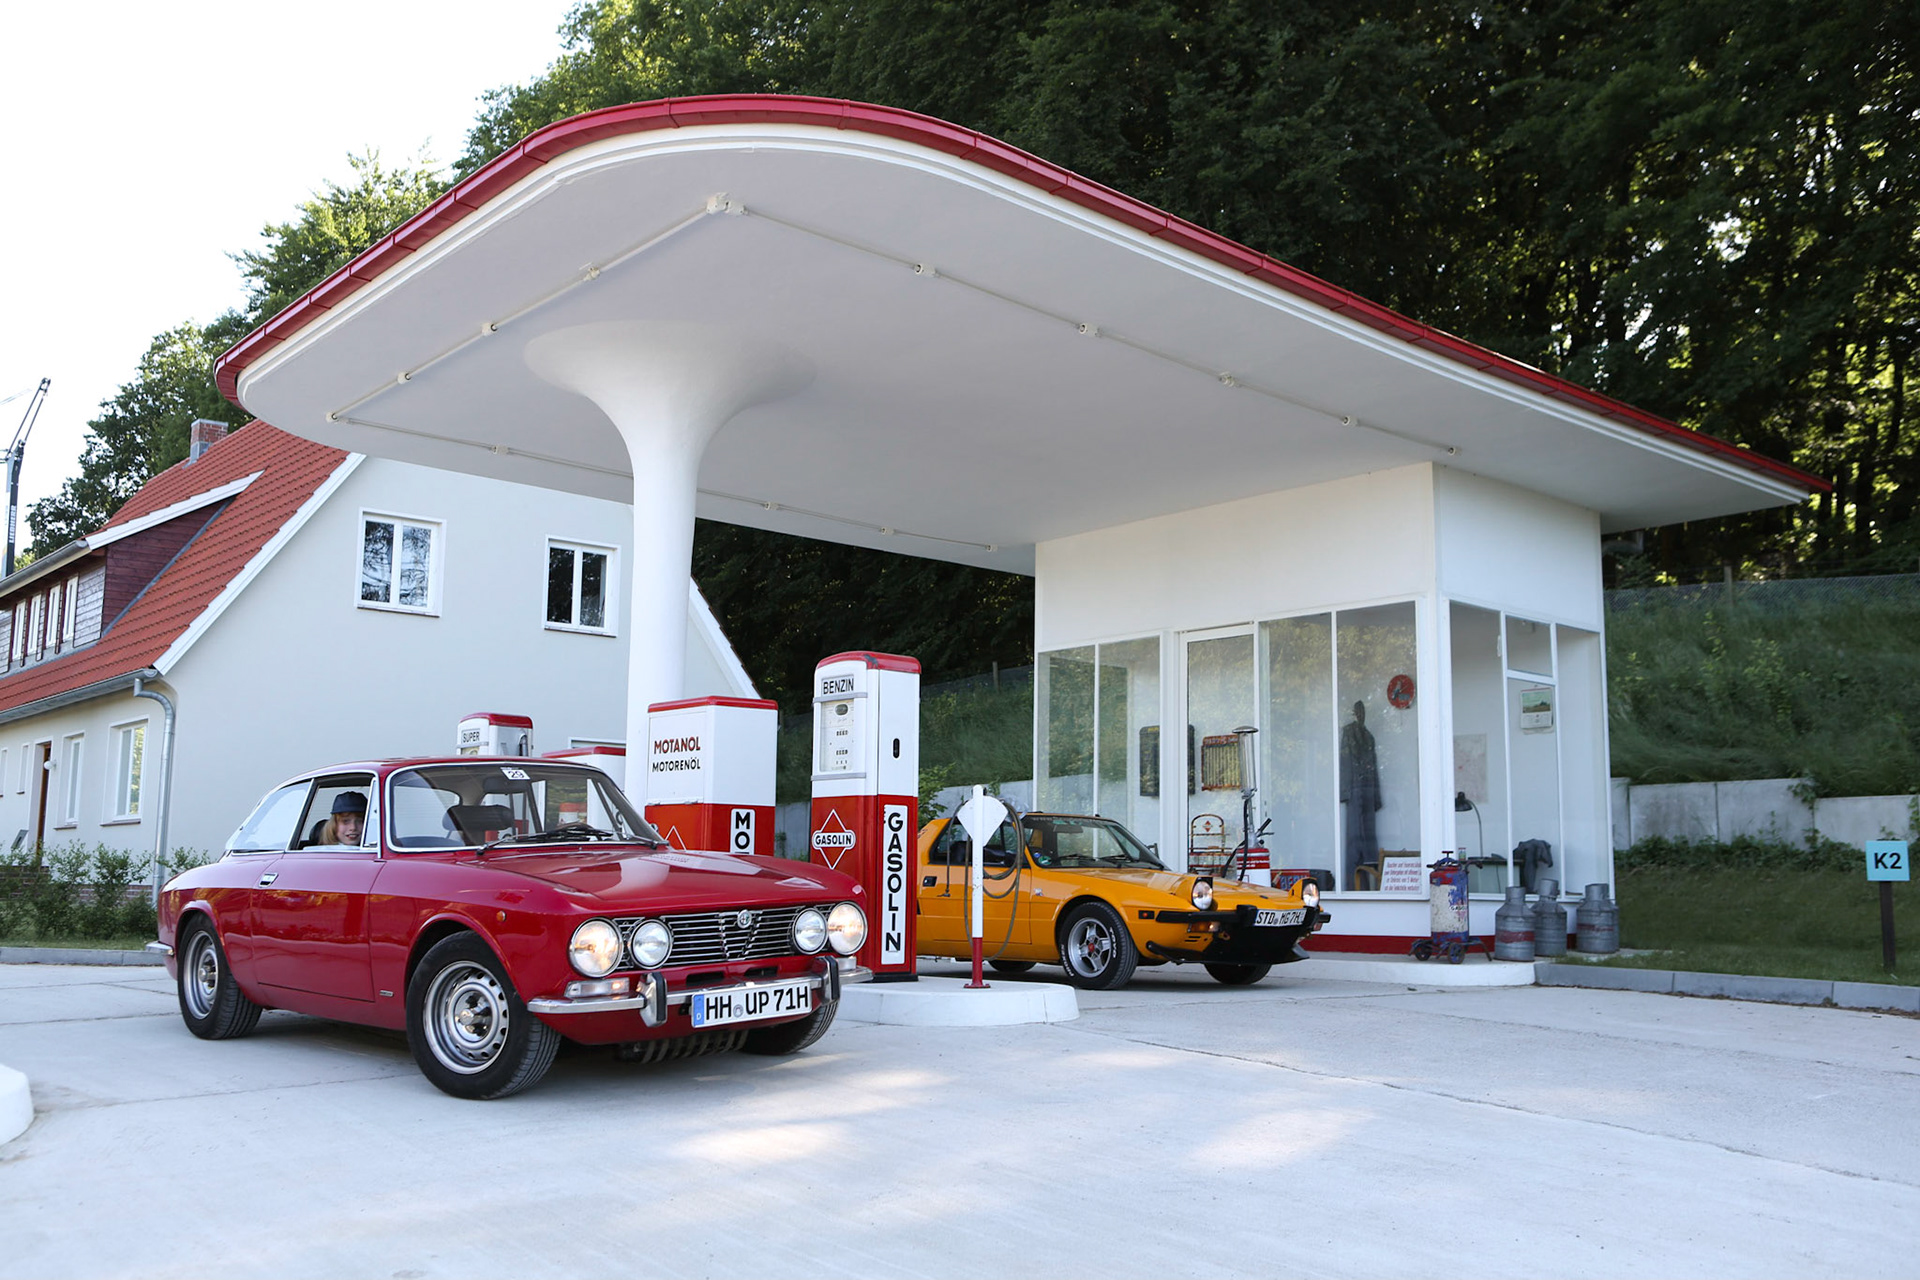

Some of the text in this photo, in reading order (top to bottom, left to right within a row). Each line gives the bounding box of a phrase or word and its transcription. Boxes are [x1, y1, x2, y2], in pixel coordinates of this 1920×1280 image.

[823, 678, 854, 695] BENZIN
[463, 731, 480, 743] SUPER
[653, 736, 701, 755] MOTANOL
[652, 757, 701, 773] MOTORENÖL
[508, 770, 525, 779] 29
[734, 811, 751, 854] MO
[815, 834, 852, 846] GASOLIN
[1874, 852, 1902, 869] K2
[885, 812, 904, 952] GASOLIN
[1257, 911, 1275, 925] STD
[706, 995, 732, 1020] HH
[745, 991, 769, 1015] UP
[774, 986, 808, 1012] 71H
